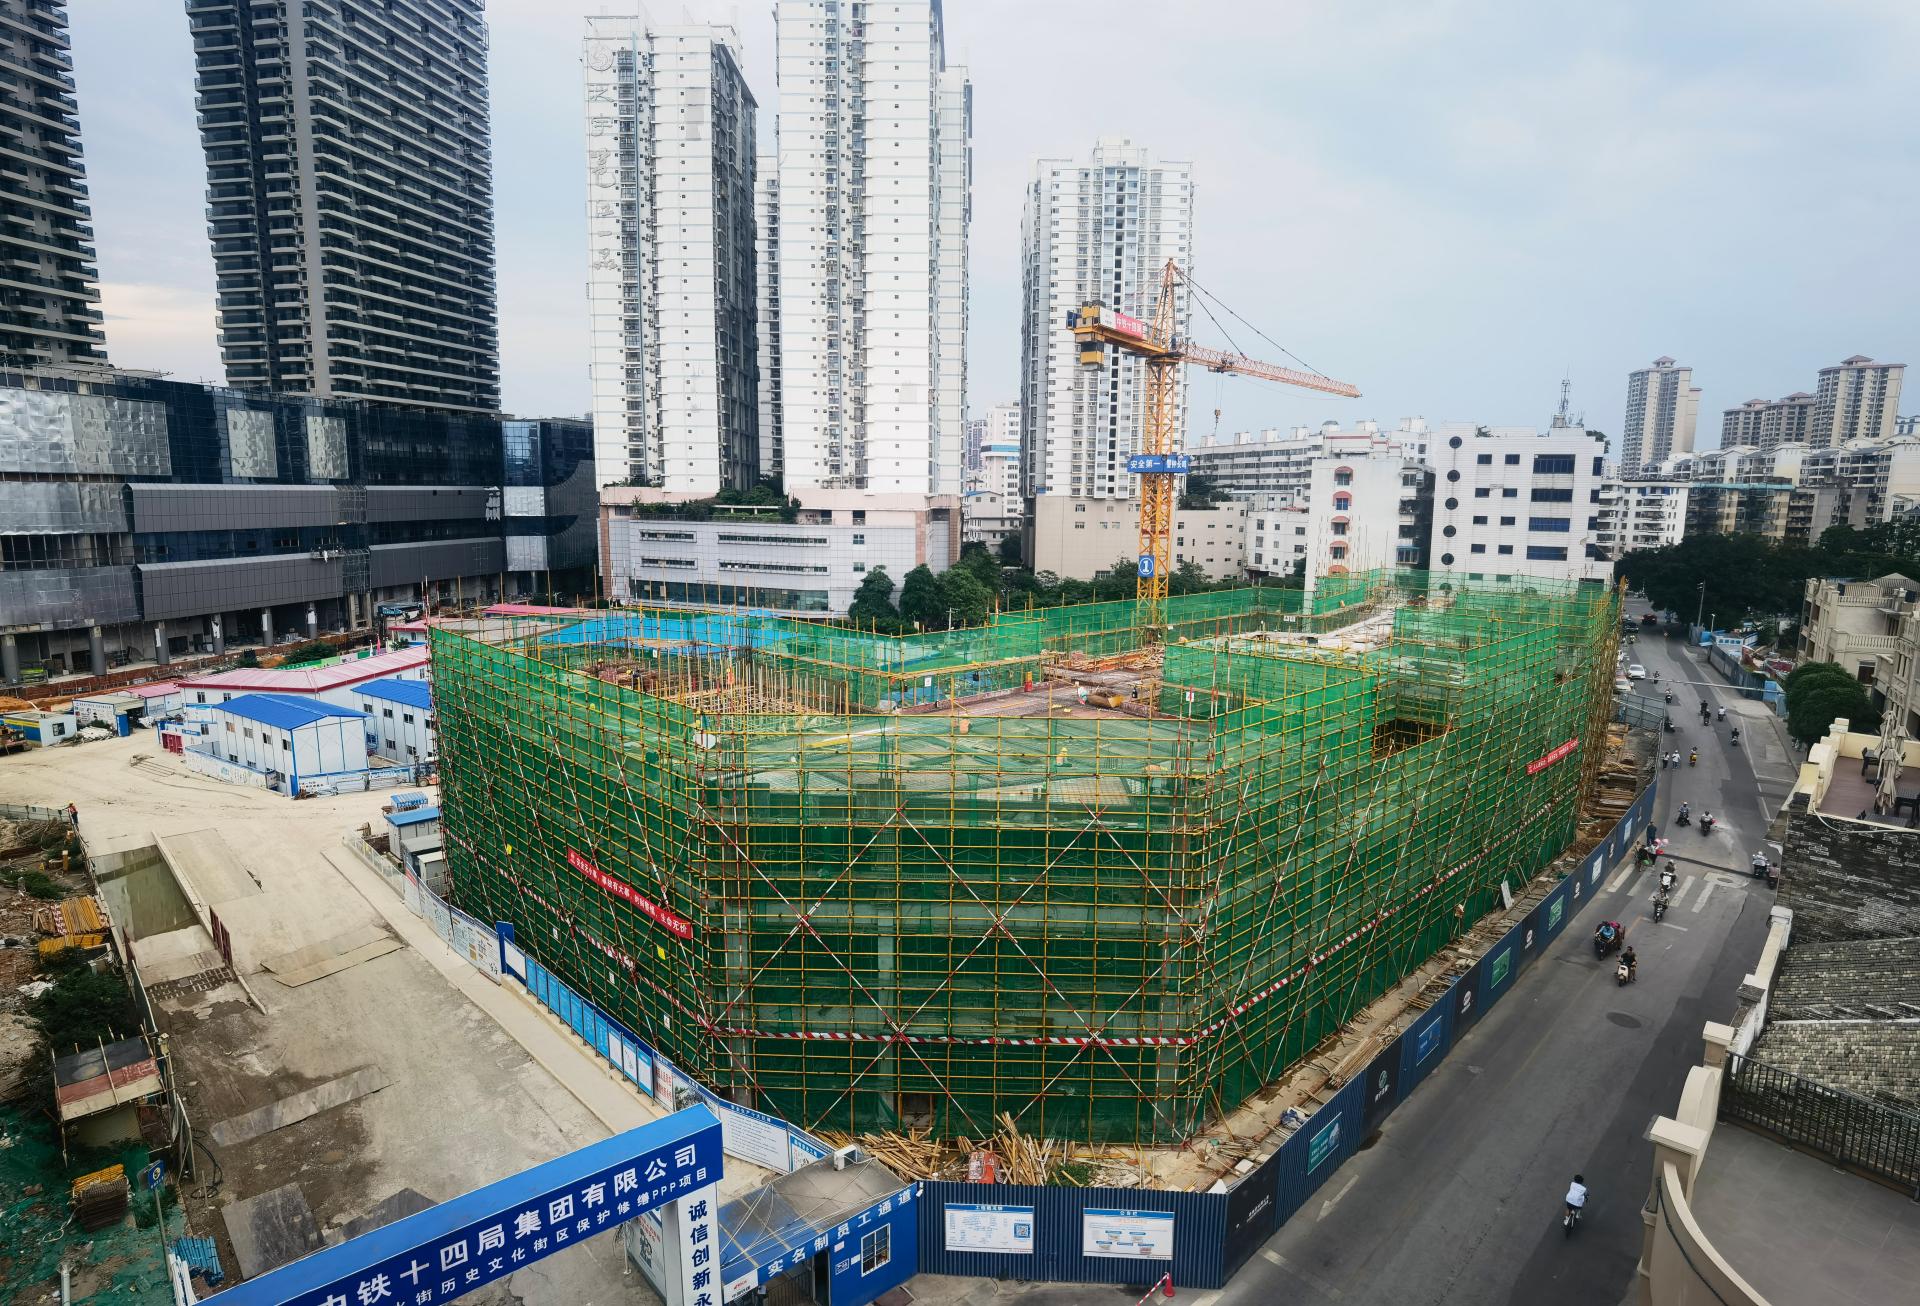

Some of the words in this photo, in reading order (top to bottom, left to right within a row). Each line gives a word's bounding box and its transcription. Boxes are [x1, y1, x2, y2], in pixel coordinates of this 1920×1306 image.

[1130, 459, 1161, 469] 安全第一
[767, 1189, 912, 1278] 实名制员工通道
